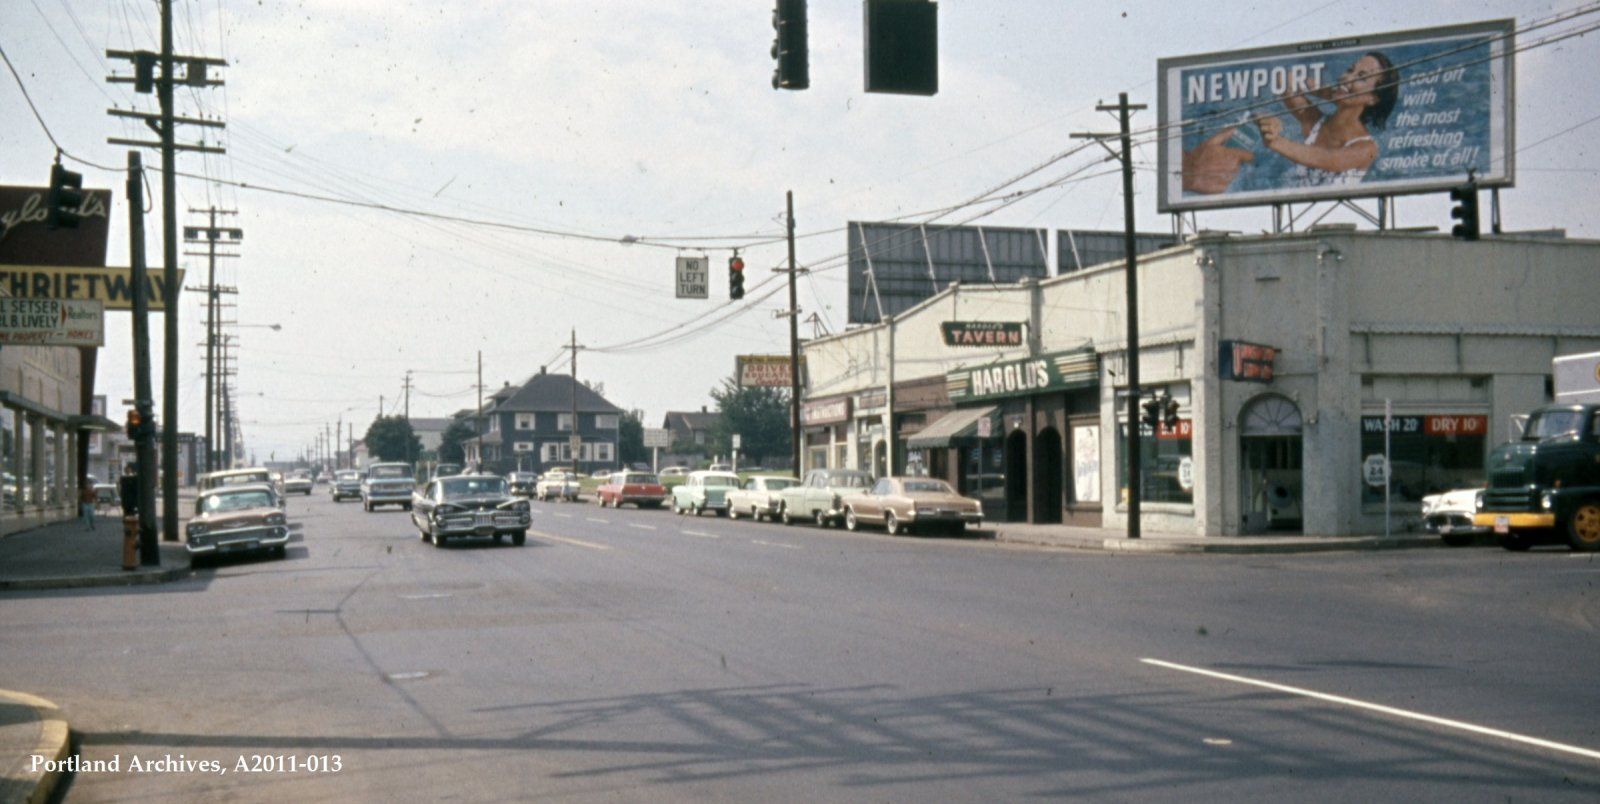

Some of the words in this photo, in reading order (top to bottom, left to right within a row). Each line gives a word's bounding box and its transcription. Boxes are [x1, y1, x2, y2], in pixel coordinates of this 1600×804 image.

[1443, 68, 1466, 83] off
[1188, 62, 1325, 104] NEWPORT
[1403, 88, 1437, 106] with
[1396, 110, 1420, 127] the
[1422, 108, 1461, 125] most
[1388, 130, 1464, 149] refreshing
[1381, 151, 1430, 171] smoke
[1432, 147, 1454, 166] of
[1451, 145, 1480, 165] all!
[686, 260, 699, 271] NO
[680, 272, 705, 283] LEFT
[680, 284, 706, 294] TURN
[11, 300, 59, 313] SETSER
[21, 315, 59, 328] LIVELY
[952, 330, 1019, 343] TAVERN
[972, 359, 1050, 396] HAROLD'S
[1432, 417, 1460, 431] DRY
